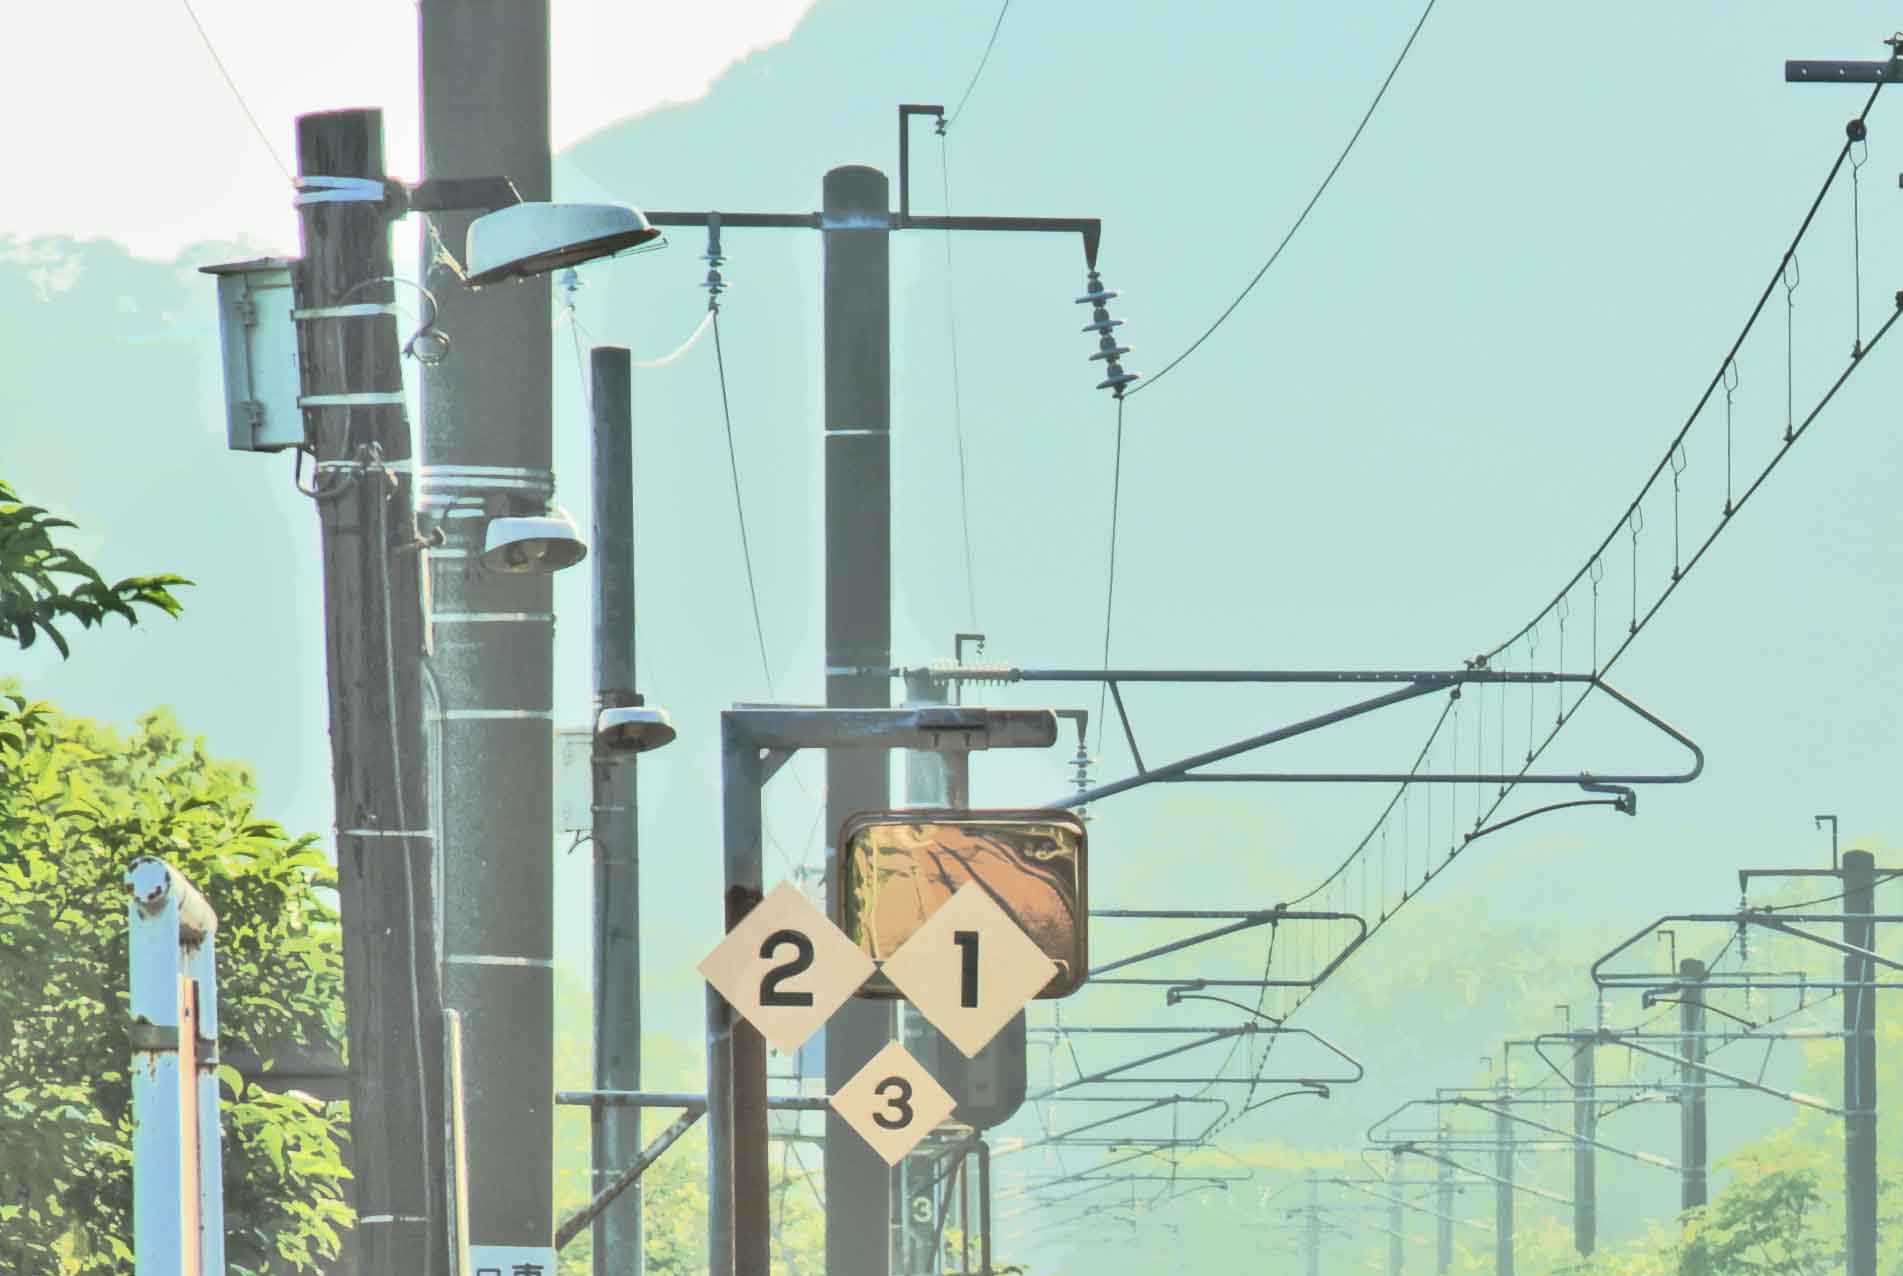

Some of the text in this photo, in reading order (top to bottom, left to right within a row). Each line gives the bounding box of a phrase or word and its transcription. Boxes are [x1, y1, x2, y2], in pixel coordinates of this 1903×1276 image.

[759, 929, 814, 1007] 2
[953, 930, 980, 1009] 1
[872, 1076, 914, 1130] 3
[912, 1196, 932, 1223] 3
